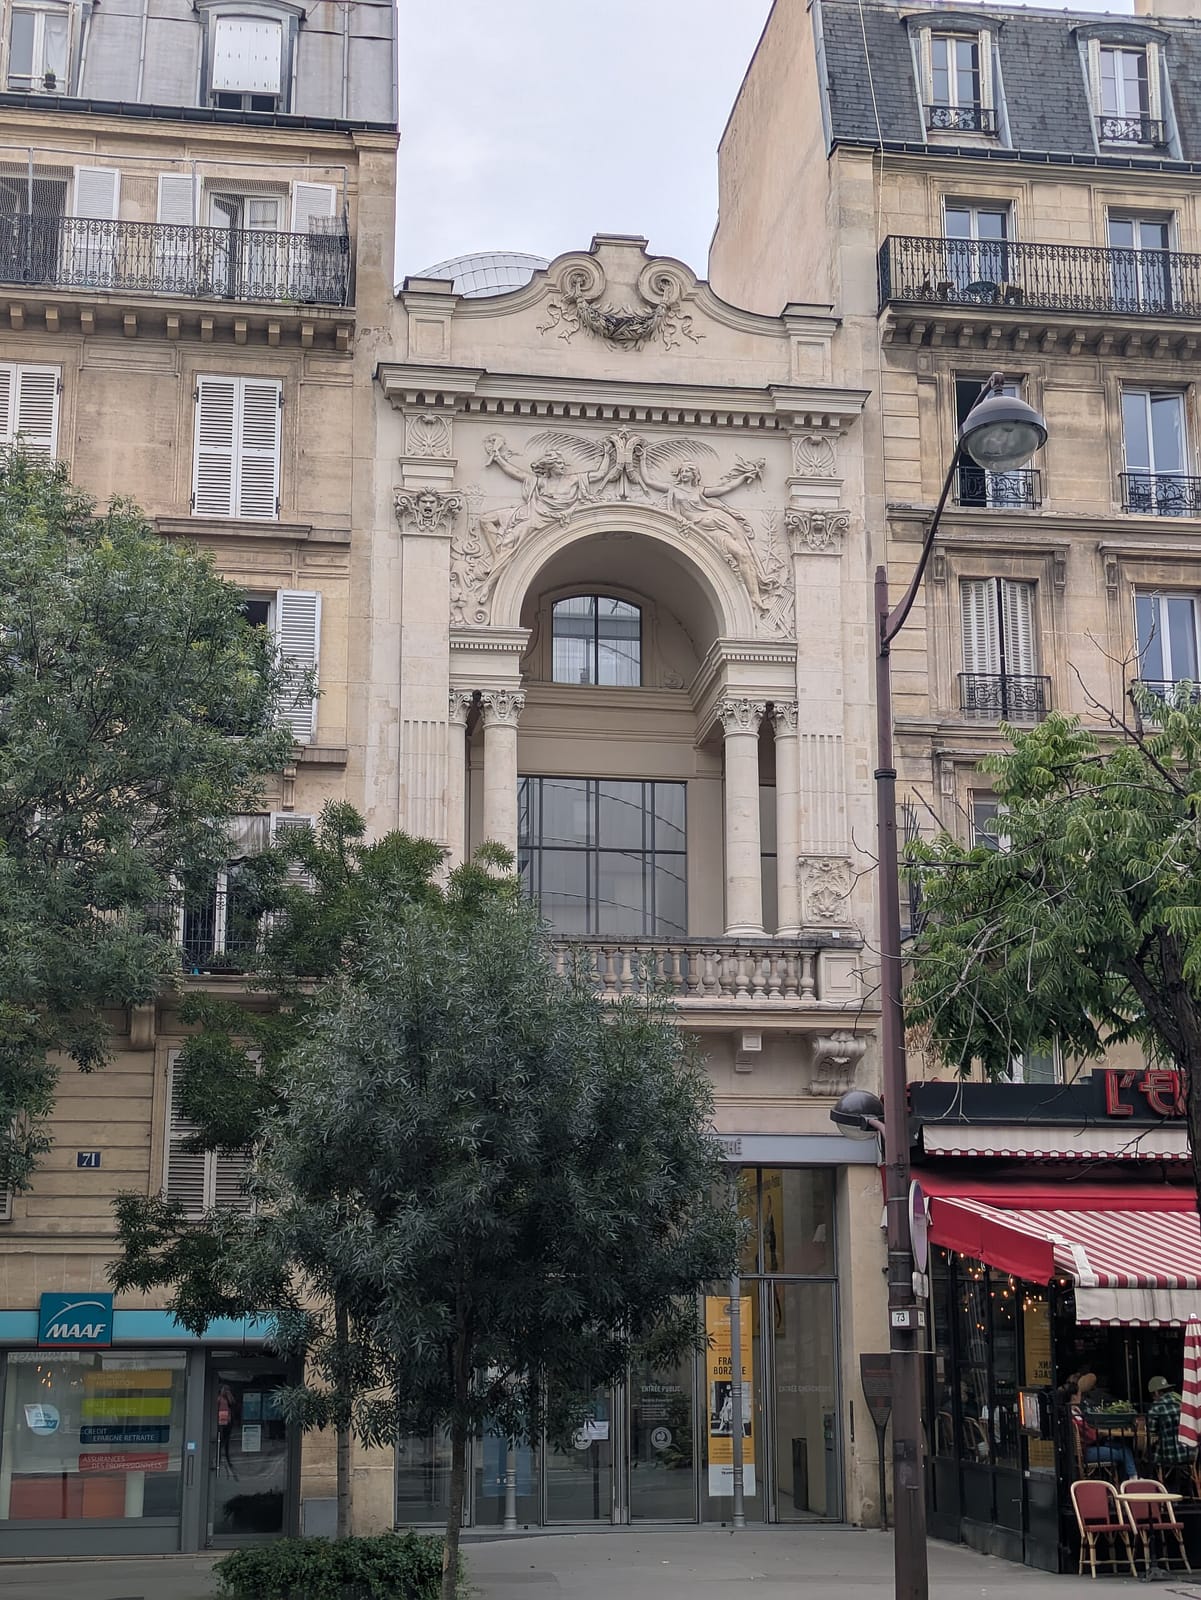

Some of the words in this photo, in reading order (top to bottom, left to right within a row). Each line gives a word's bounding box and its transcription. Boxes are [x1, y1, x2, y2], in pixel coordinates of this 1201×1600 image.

[1105, 1069, 1188, 1116] L'E
[82, 1153, 95, 1166] 71
[896, 1312, 905, 1322] 73
[45, 1323, 106, 1338] MAAF
[713, 1366, 747, 1375] BORZE
